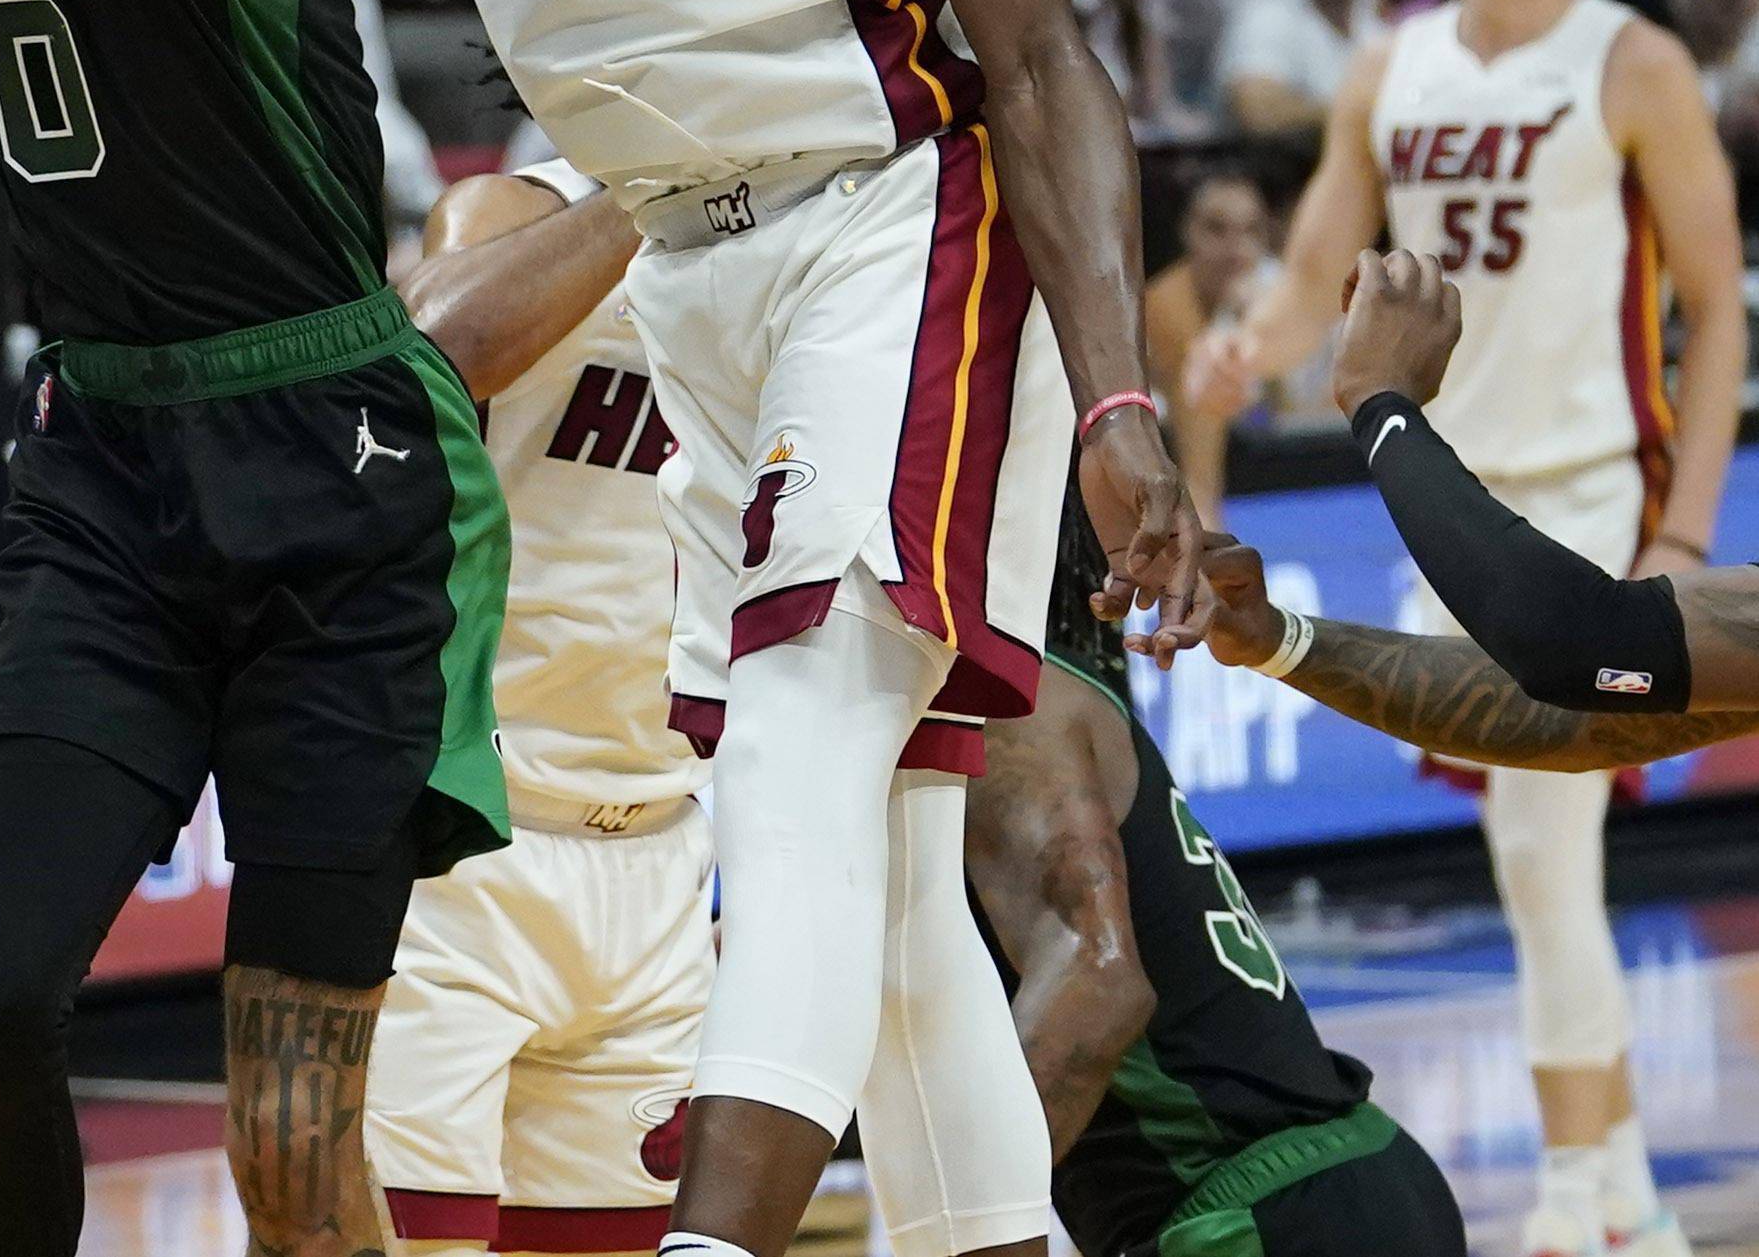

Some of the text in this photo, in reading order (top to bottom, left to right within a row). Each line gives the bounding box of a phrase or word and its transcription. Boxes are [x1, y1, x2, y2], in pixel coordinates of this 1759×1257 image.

[1390, 101, 1574, 184] HEAT
[1440, 198, 1530, 273] 55
[228, 996, 380, 1067] ATEFU
